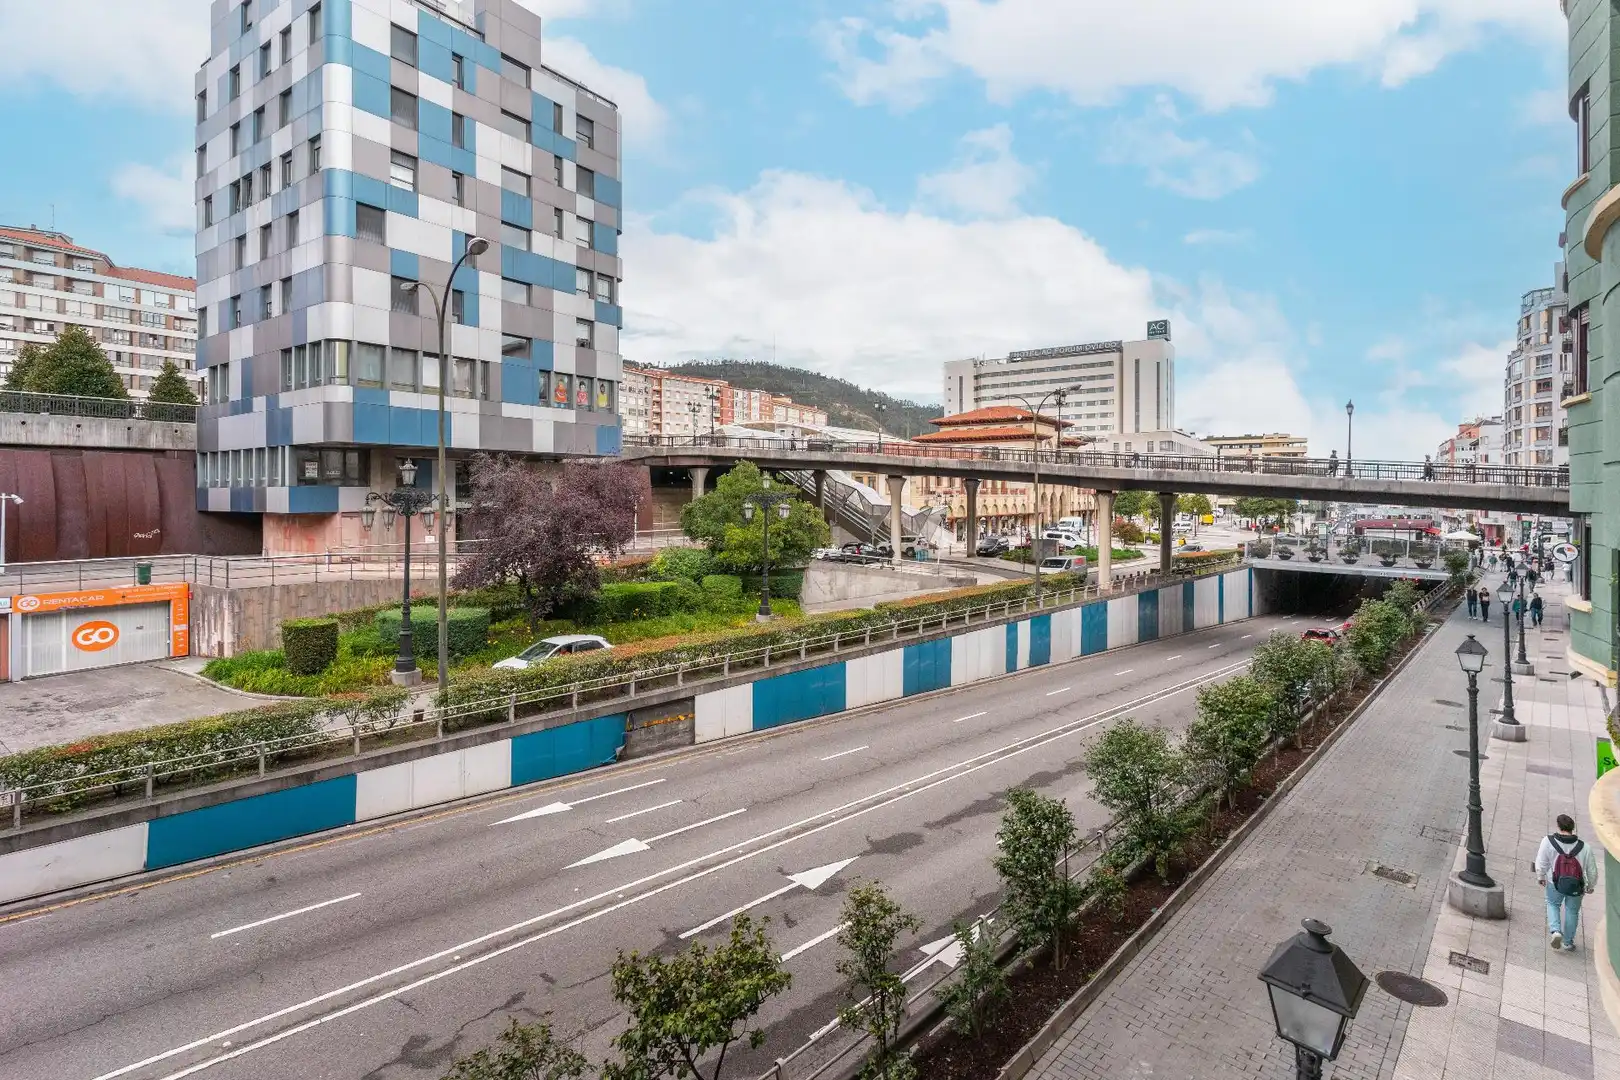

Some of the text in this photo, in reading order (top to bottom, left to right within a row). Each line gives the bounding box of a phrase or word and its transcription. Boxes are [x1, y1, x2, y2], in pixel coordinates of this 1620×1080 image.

[1149, 321, 1166, 331] AC
[1054, 345, 1083, 354] FORUM
[1085, 341, 1118, 351] OVIEDO
[76, 628, 114, 645] GO
